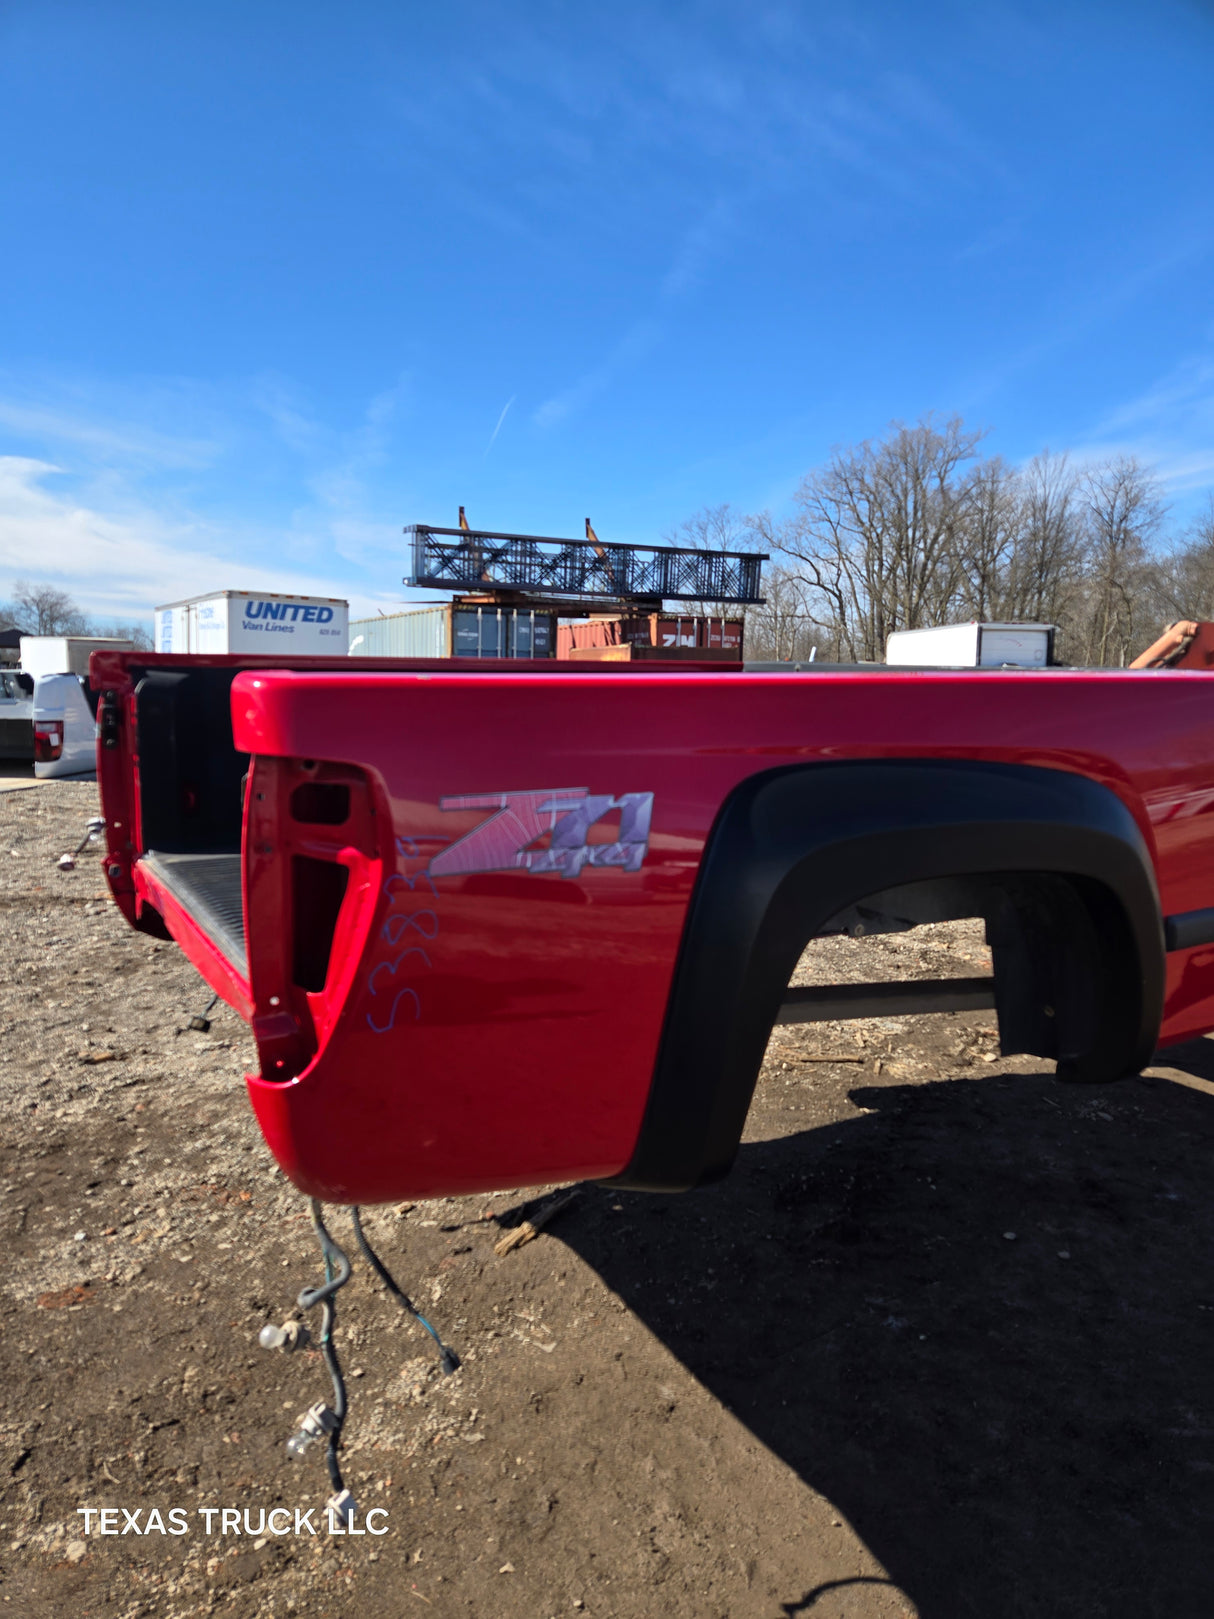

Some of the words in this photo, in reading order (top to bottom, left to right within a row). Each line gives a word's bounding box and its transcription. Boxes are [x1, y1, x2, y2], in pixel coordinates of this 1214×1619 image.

[245, 601, 334, 624] UNITED
[242, 620, 264, 632] Van
[265, 622, 295, 634] Lines
[429, 787, 654, 877] Z71
